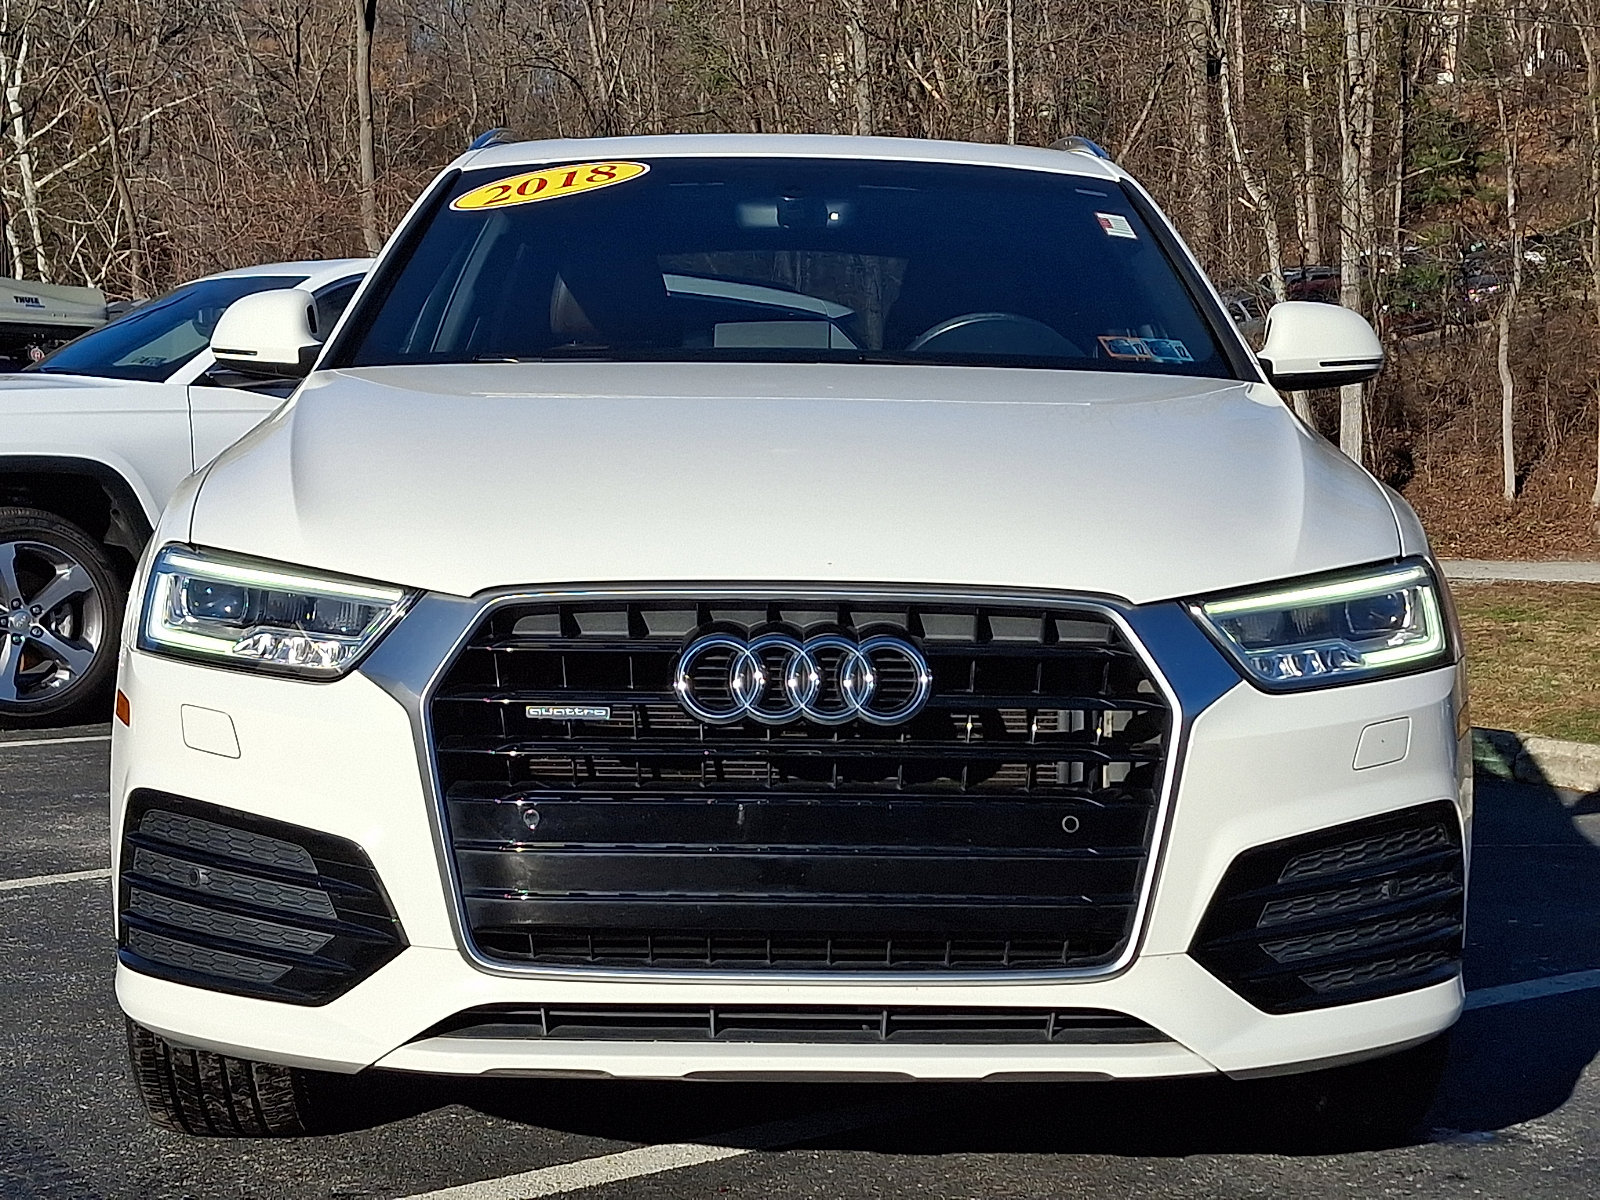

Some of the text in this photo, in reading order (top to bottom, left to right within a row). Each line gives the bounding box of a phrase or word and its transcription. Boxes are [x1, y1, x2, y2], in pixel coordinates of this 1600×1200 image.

[482, 165, 618, 206] 2018
[13, 295, 40, 304] THULE
[527, 707, 607, 716] quattro
